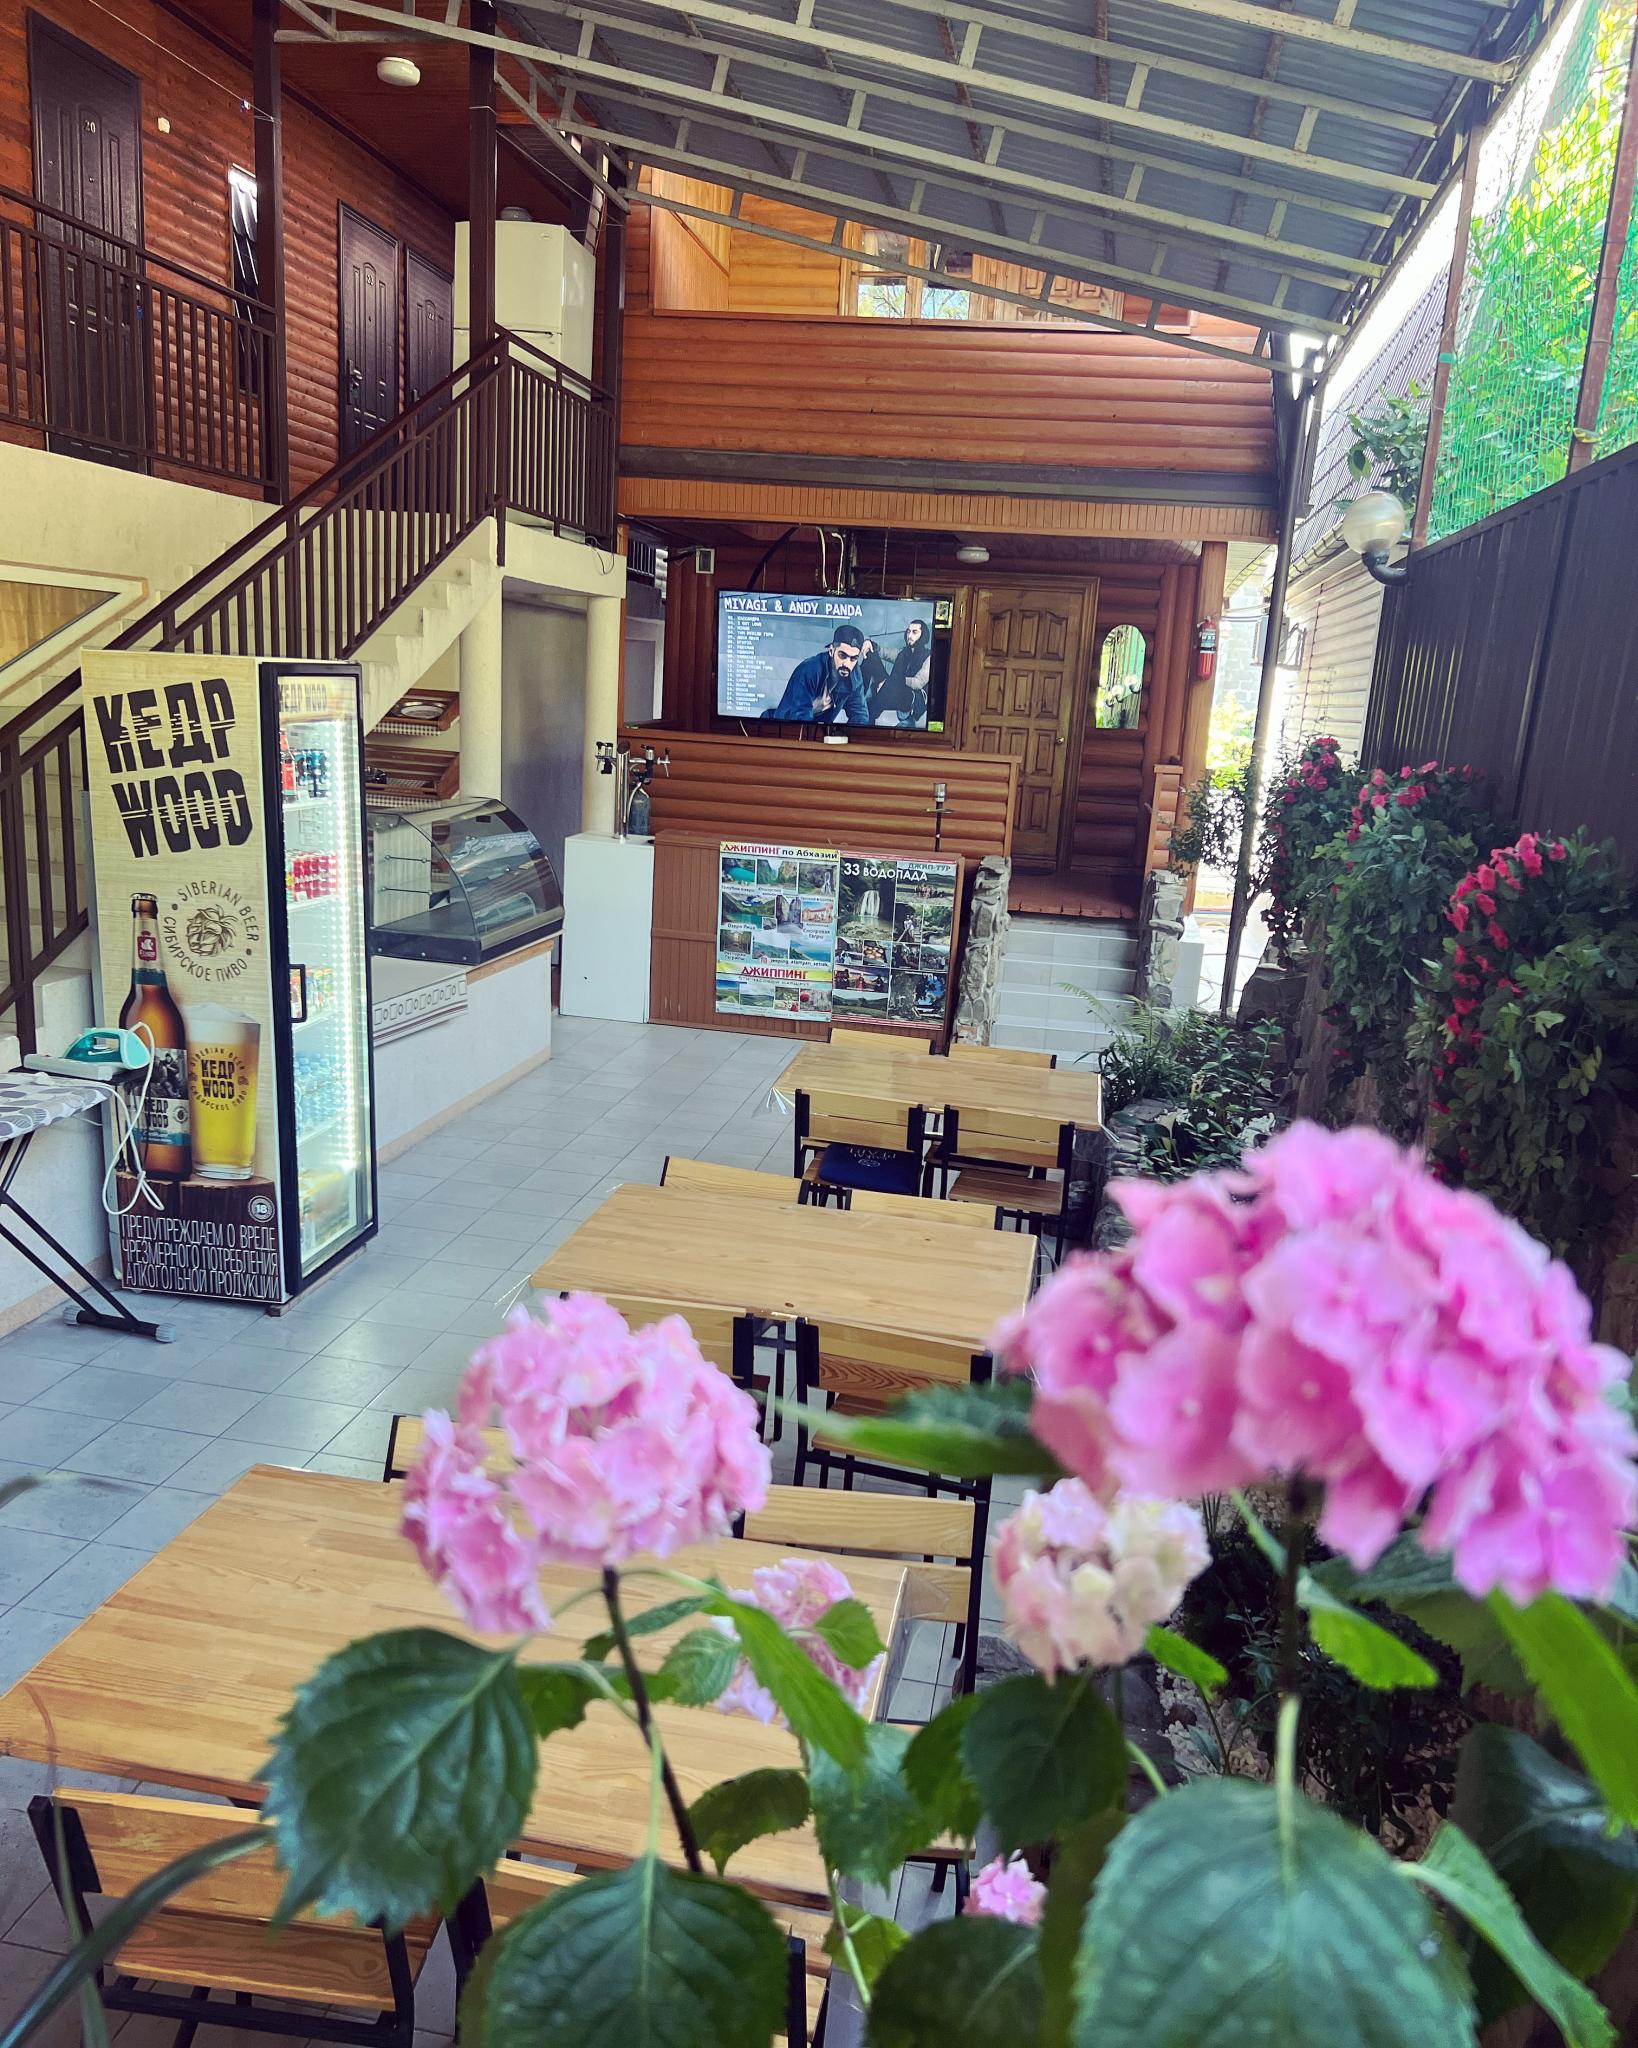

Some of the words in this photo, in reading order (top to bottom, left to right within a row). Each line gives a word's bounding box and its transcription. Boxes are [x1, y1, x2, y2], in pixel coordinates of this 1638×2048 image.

[724, 598, 768, 611] MIYAGI
[774, 600, 783, 612] &
[788, 601, 819, 614] ANDY
[825, 603, 863, 616] PANDA
[93, 678, 236, 774] КЕДР
[111, 769, 253, 858] WOOD
[723, 844, 781, 855] ДЖИППИНГ
[796, 849, 838, 859] Абхазии
[843, 863, 860, 876] 33
[863, 867, 928, 881] ВОДОПАДА
[178, 880, 242, 906] SIBERIAN
[239, 906, 260, 941] BEER
[163, 916, 212, 981] СИБИРСКОЕ
[216, 958, 248, 981] ПИВО
[741, 966, 809, 980] ДЖИППИНГ
[201, 1059, 235, 1079] КЕДР
[202, 1079, 235, 1099] WOOD
[121, 1214, 224, 1246] ПРЕДУПРЕЖДАЕМ
[226, 1223, 236, 1247] О
[240, 1224, 276, 1251] ВРЕДЕ
[121, 1239, 200, 1269] ЧРЕЗМЕРНОГО
[202, 1246, 279, 1276] ПОТРЕБЛЕНИЯ
[126, 1263, 207, 1293] АЛКОГОЛЬНОЙ
[209, 1270, 279, 1299] ПРОДУКЦИИ
